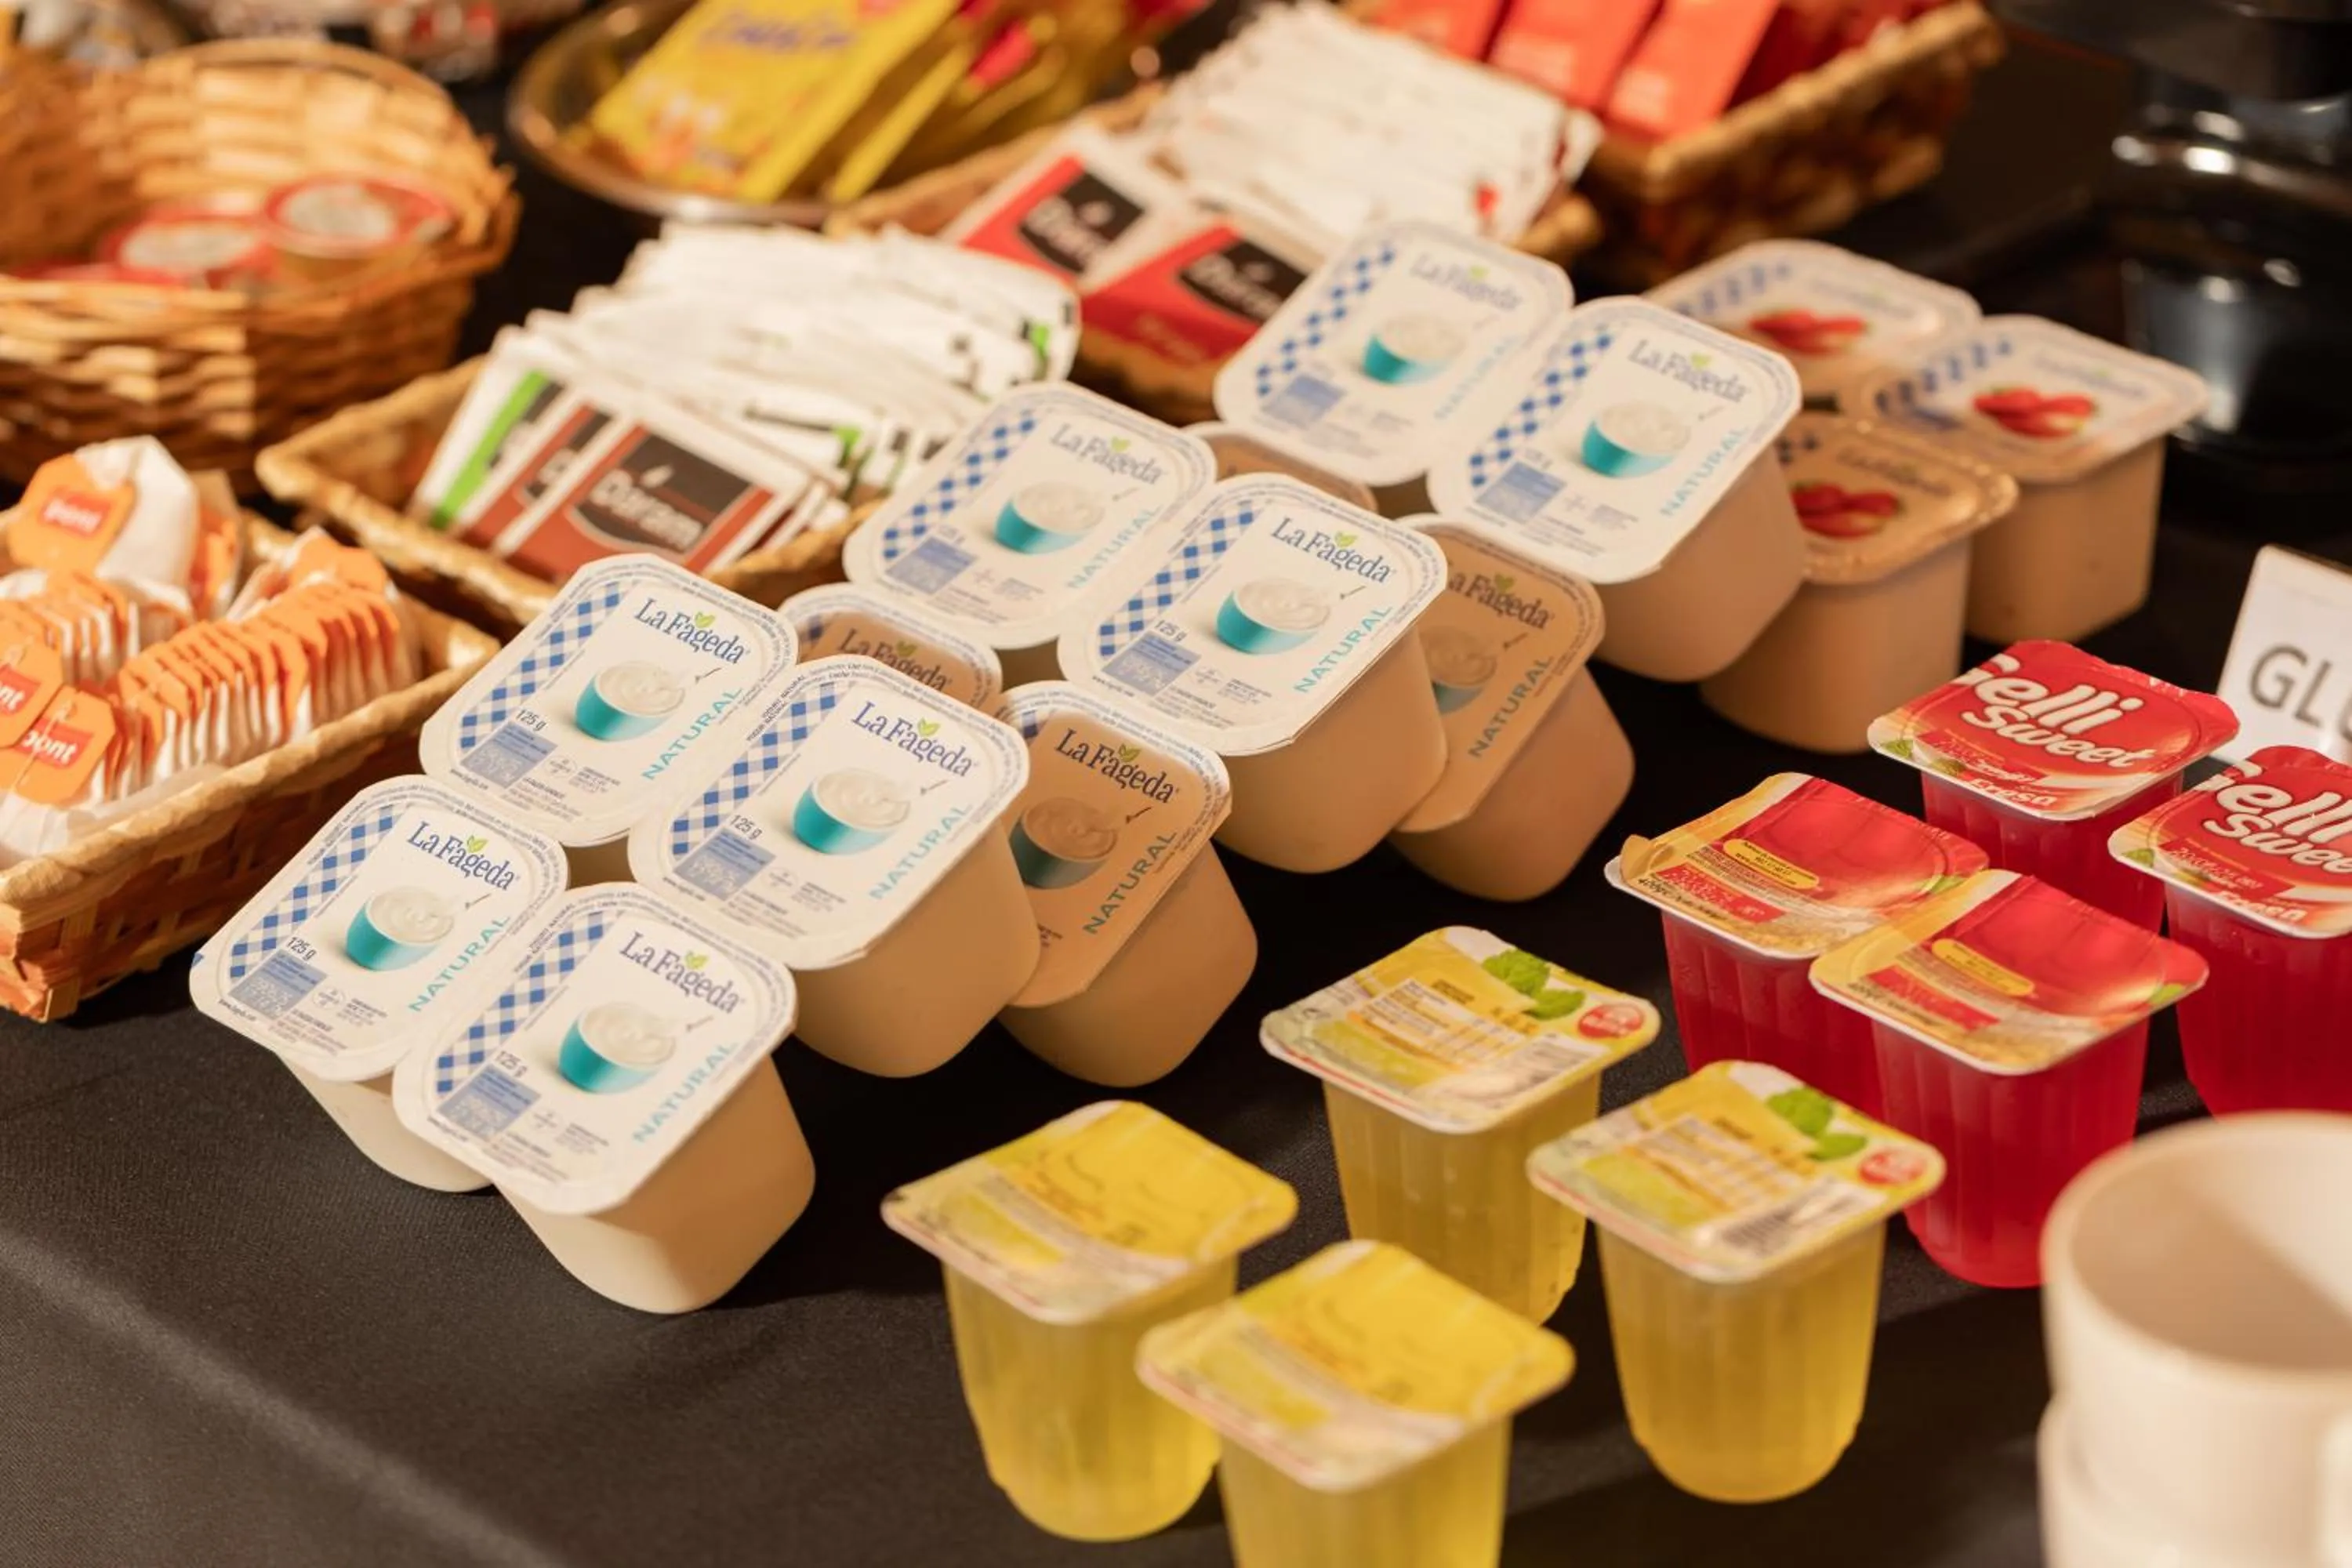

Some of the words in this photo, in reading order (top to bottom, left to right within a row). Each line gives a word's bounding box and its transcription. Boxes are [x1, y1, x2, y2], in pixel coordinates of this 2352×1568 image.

[1067, 505, 1162, 590] NATURAL
[1270, 517, 1303, 552] La
[1301, 532, 1392, 584] Fageda
[633, 597, 663, 630] La
[662, 612, 746, 665] Fageda
[1465, 574, 1552, 630] Fageda
[1294, 604, 1393, 693] NATURAL
[516, 709, 536, 728] 125
[641, 688, 744, 779] NATURAL
[851, 701, 885, 738] La
[884, 717, 974, 777] Fageda
[1468, 655, 1552, 758] NATURAL
[1056, 728, 1087, 764] La
[1087, 743, 1175, 804] Fageda
[406, 821, 437, 856] La
[435, 833, 517, 891] Fageda
[730, 814, 752, 835] 125
[869, 804, 974, 900] NATURAL
[1083, 832, 1178, 934] NATURAL
[286, 935, 307, 958] 125
[408, 916, 510, 1012] NATURAL
[619, 931, 652, 971] La
[648, 949, 742, 1014] Fageda
[632, 1041, 739, 1144] NATURAL
